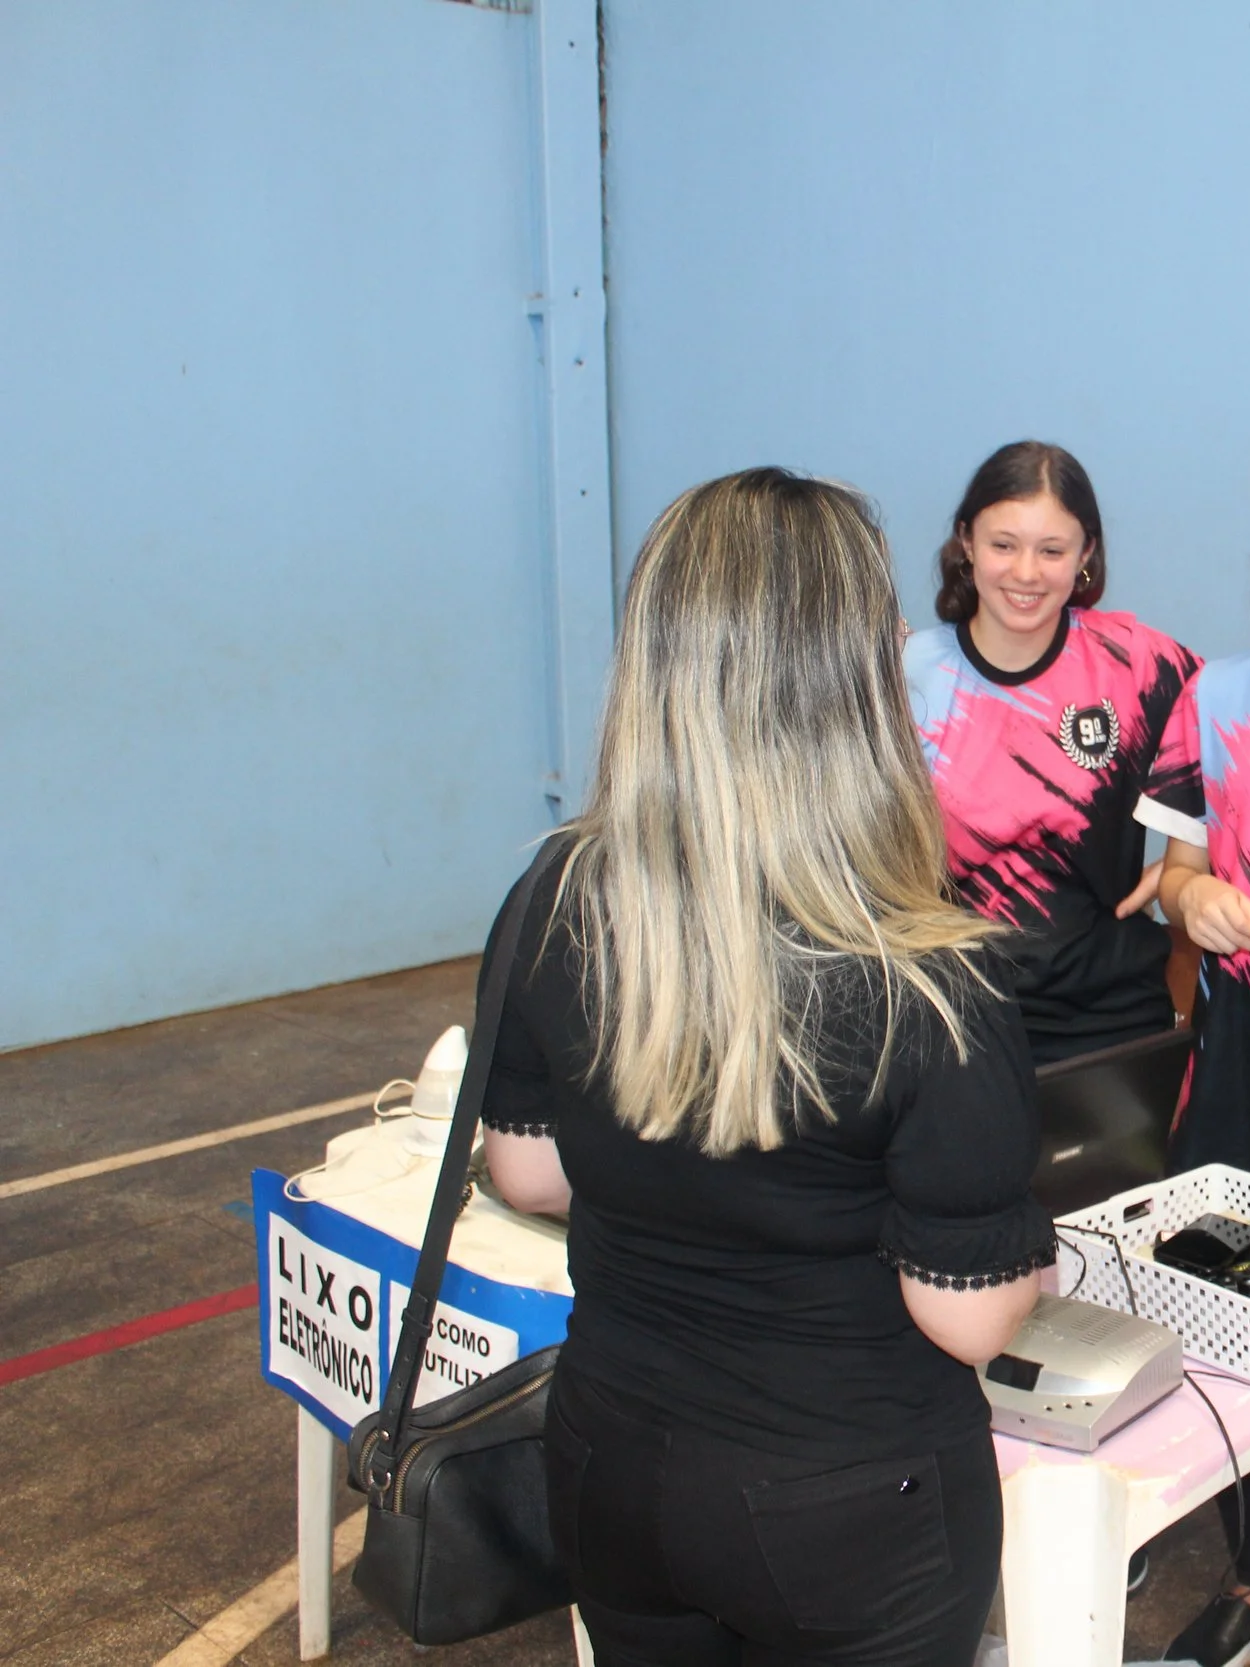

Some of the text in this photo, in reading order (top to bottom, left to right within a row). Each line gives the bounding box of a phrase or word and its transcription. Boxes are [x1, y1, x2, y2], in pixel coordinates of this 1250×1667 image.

[278, 1236, 373, 1331] LIXO
[279, 1296, 373, 1405] ELETRÔNICO
[425, 1350, 494, 1387] UTILIZ
[437, 1318, 490, 1357] COMO
